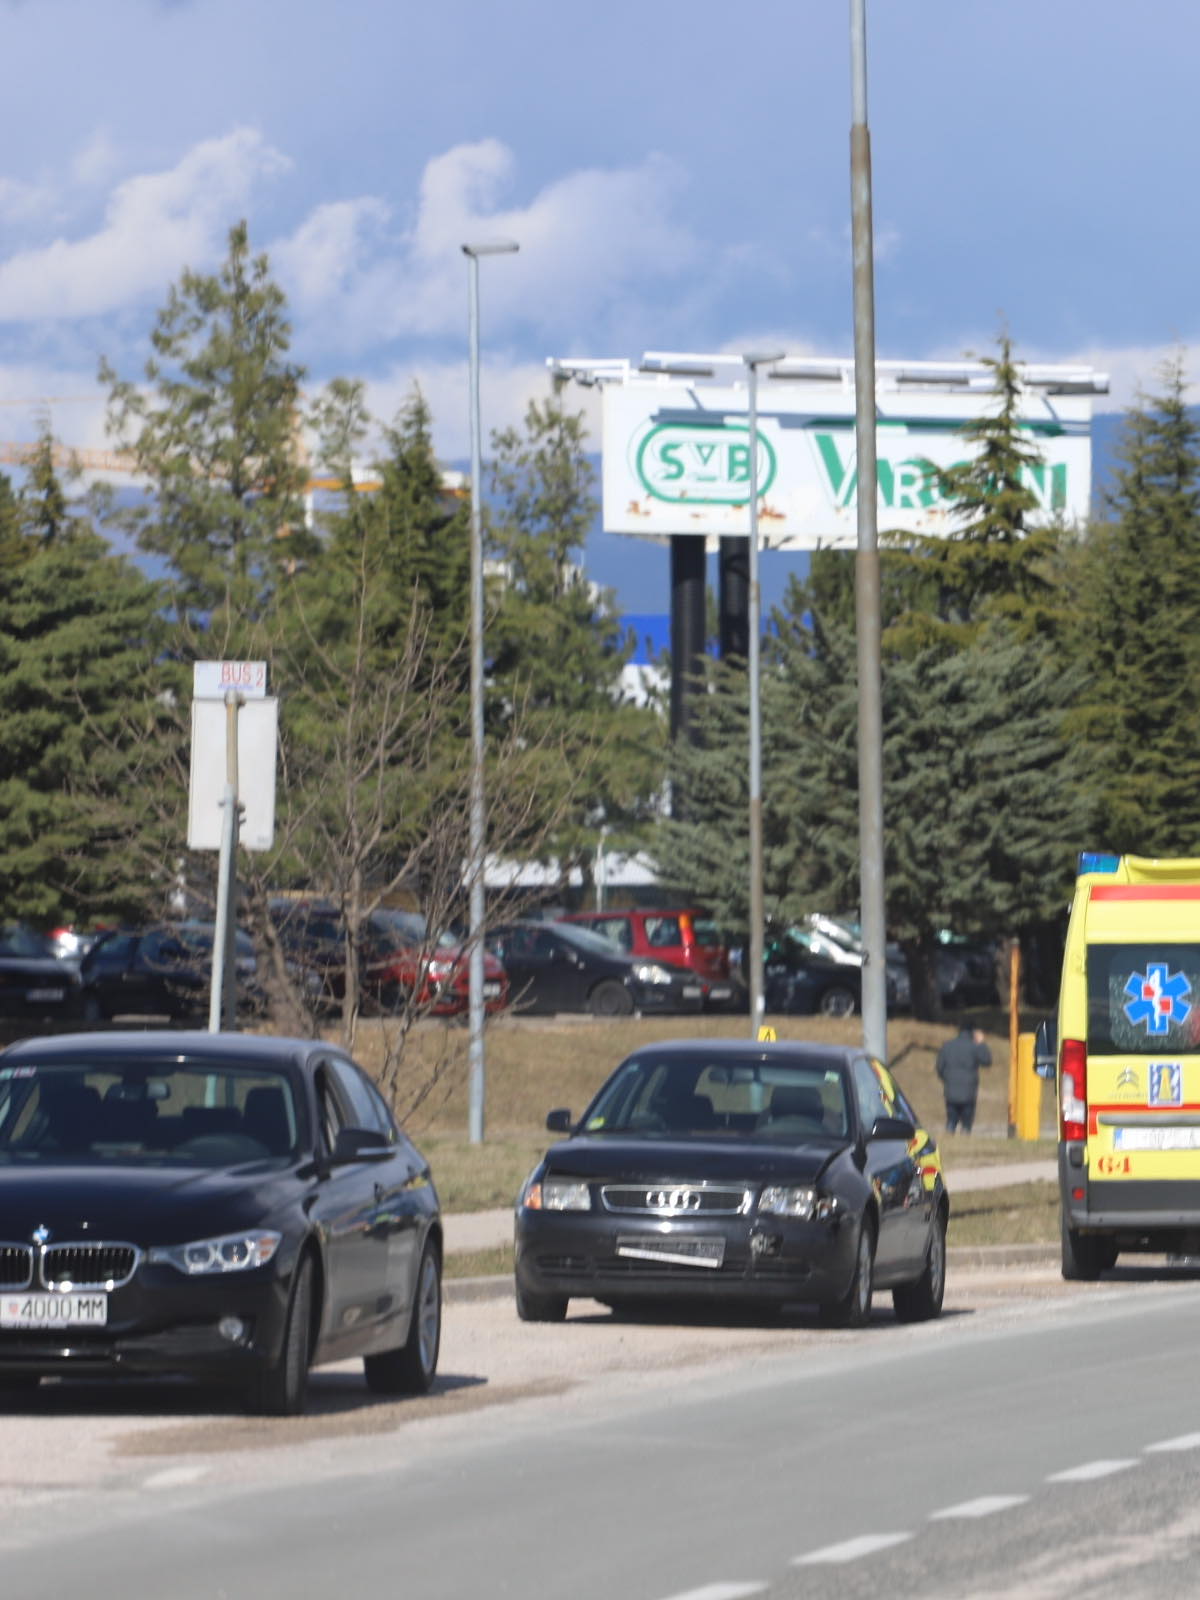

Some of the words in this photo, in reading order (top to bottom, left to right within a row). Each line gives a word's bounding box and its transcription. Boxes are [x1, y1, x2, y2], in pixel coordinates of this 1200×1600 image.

[221, 662, 252, 684] BUS
[21, 1299, 72, 1320] 4000
[77, 1298, 104, 1320] MM
